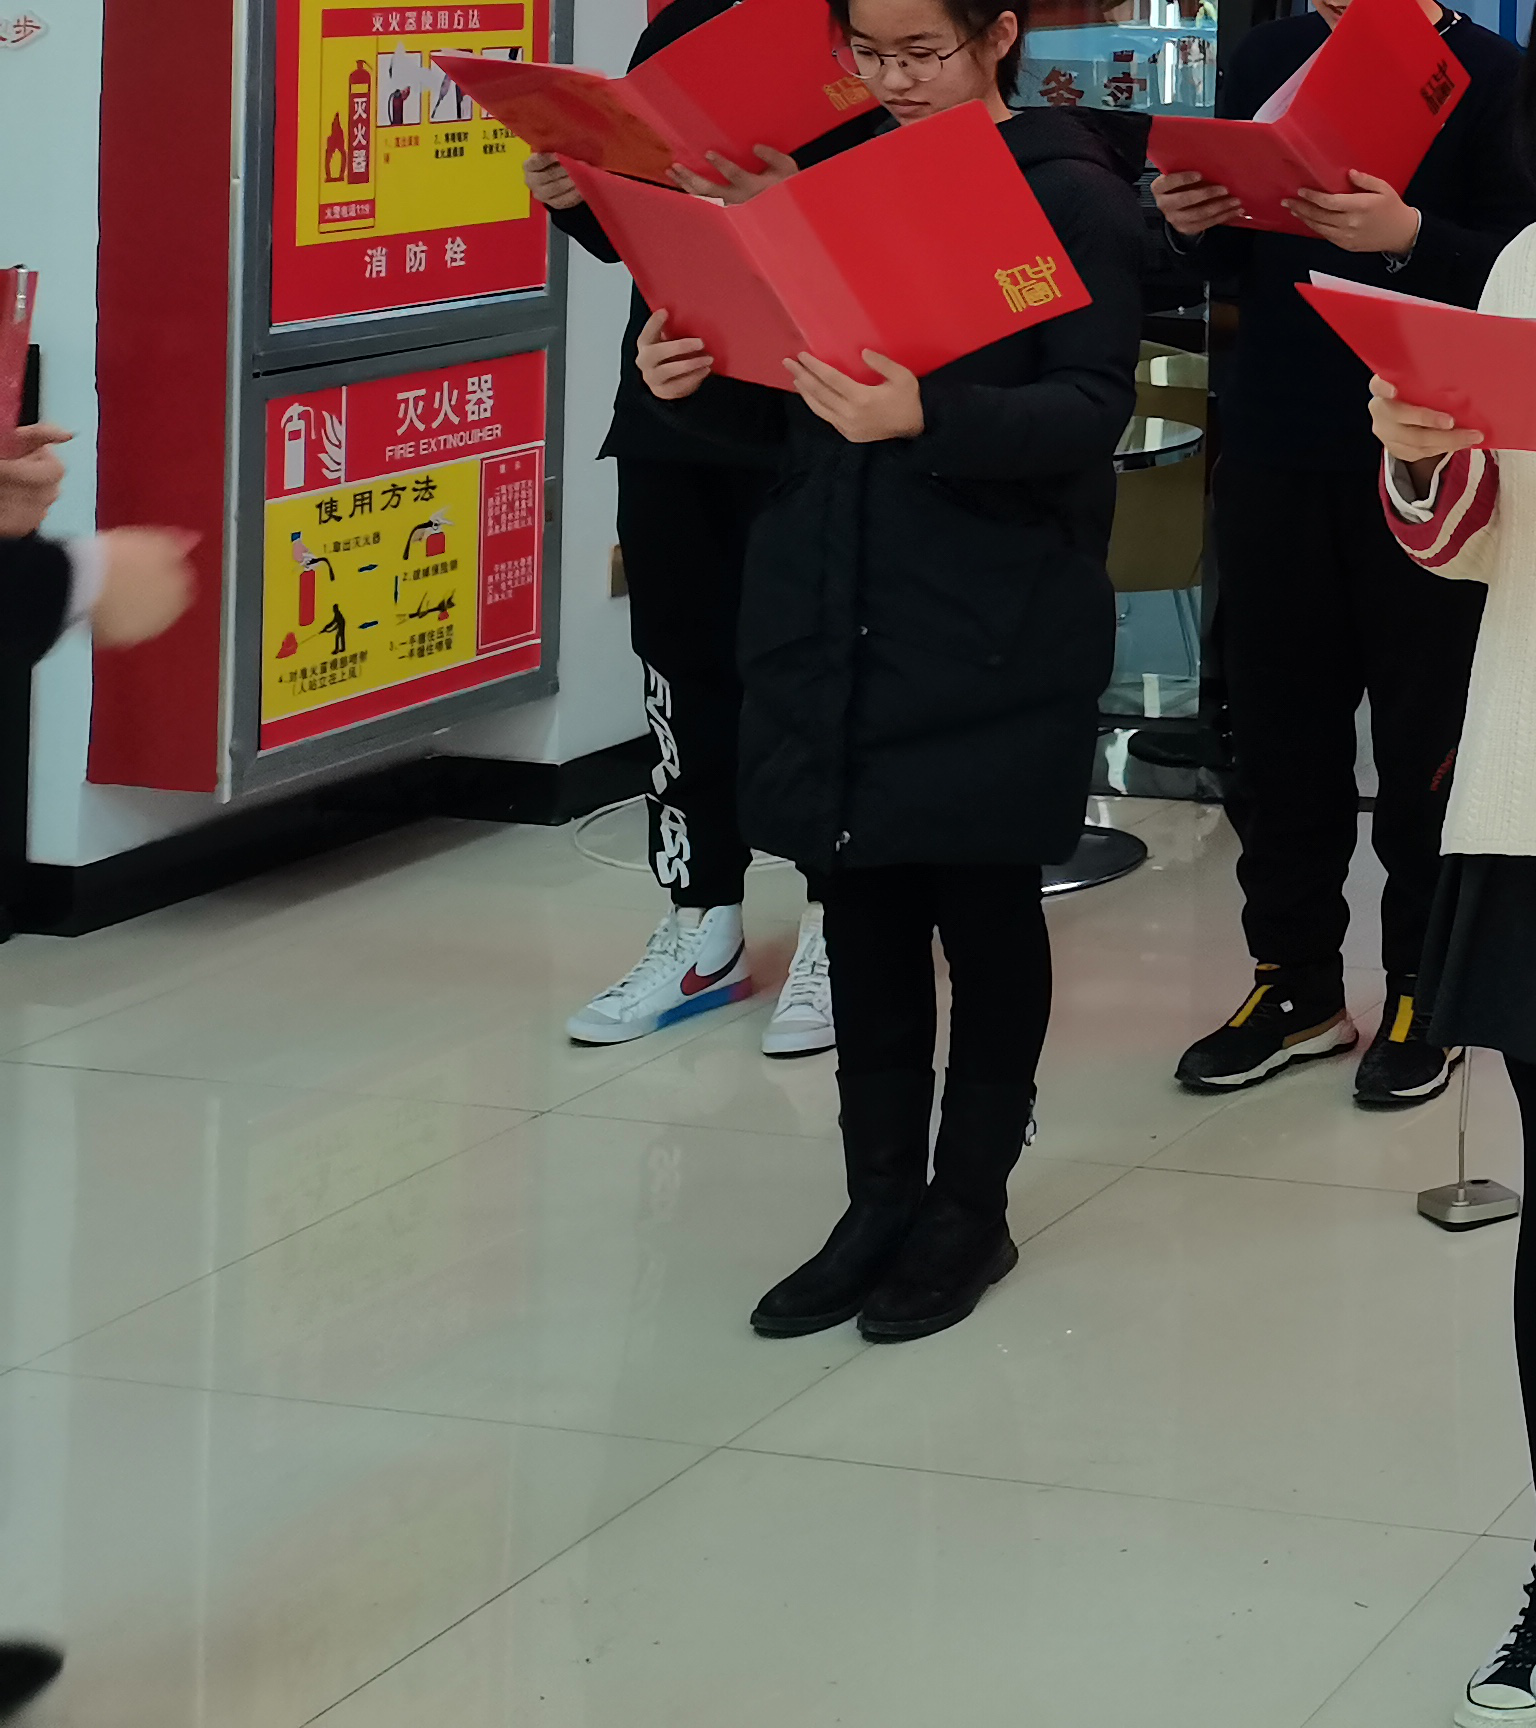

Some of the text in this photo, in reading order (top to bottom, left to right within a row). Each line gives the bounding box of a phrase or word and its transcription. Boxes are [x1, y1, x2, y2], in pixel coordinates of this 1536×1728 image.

[372, 9, 481, 32] 灭火器使用方法
[352, 97, 368, 173] 灭火器
[363, 236, 468, 279] 消防栓
[395, 373, 495, 437] 灭火器
[385, 440, 417, 463] FIRE
[315, 475, 438, 525] 使用方法
